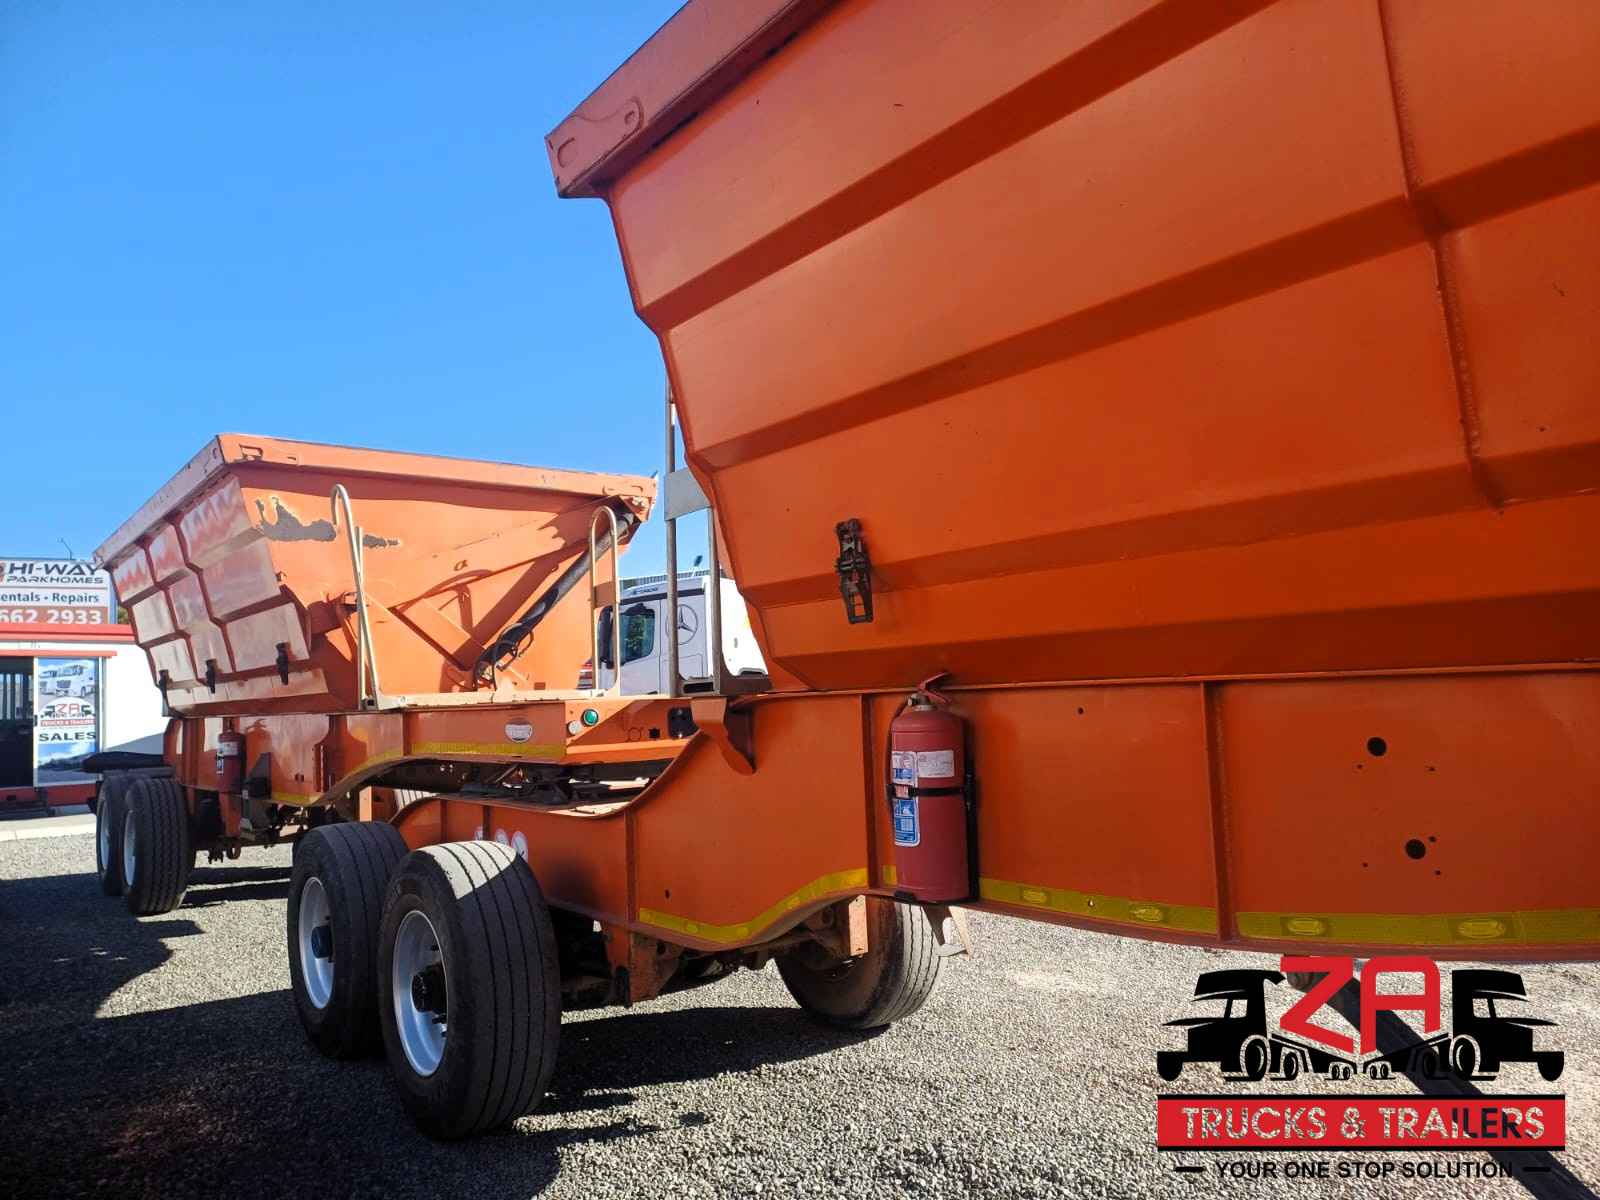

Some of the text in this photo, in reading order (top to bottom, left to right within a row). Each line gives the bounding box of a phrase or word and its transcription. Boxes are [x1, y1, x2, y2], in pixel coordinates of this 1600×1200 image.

[8, 563, 98, 575] HI-WAY
[7, 576, 104, 584] PARKHOMES
[52, 592, 99, 604] Repairs
[0, 609, 102, 625] 662 2933
[39, 732, 96, 741] SALES
